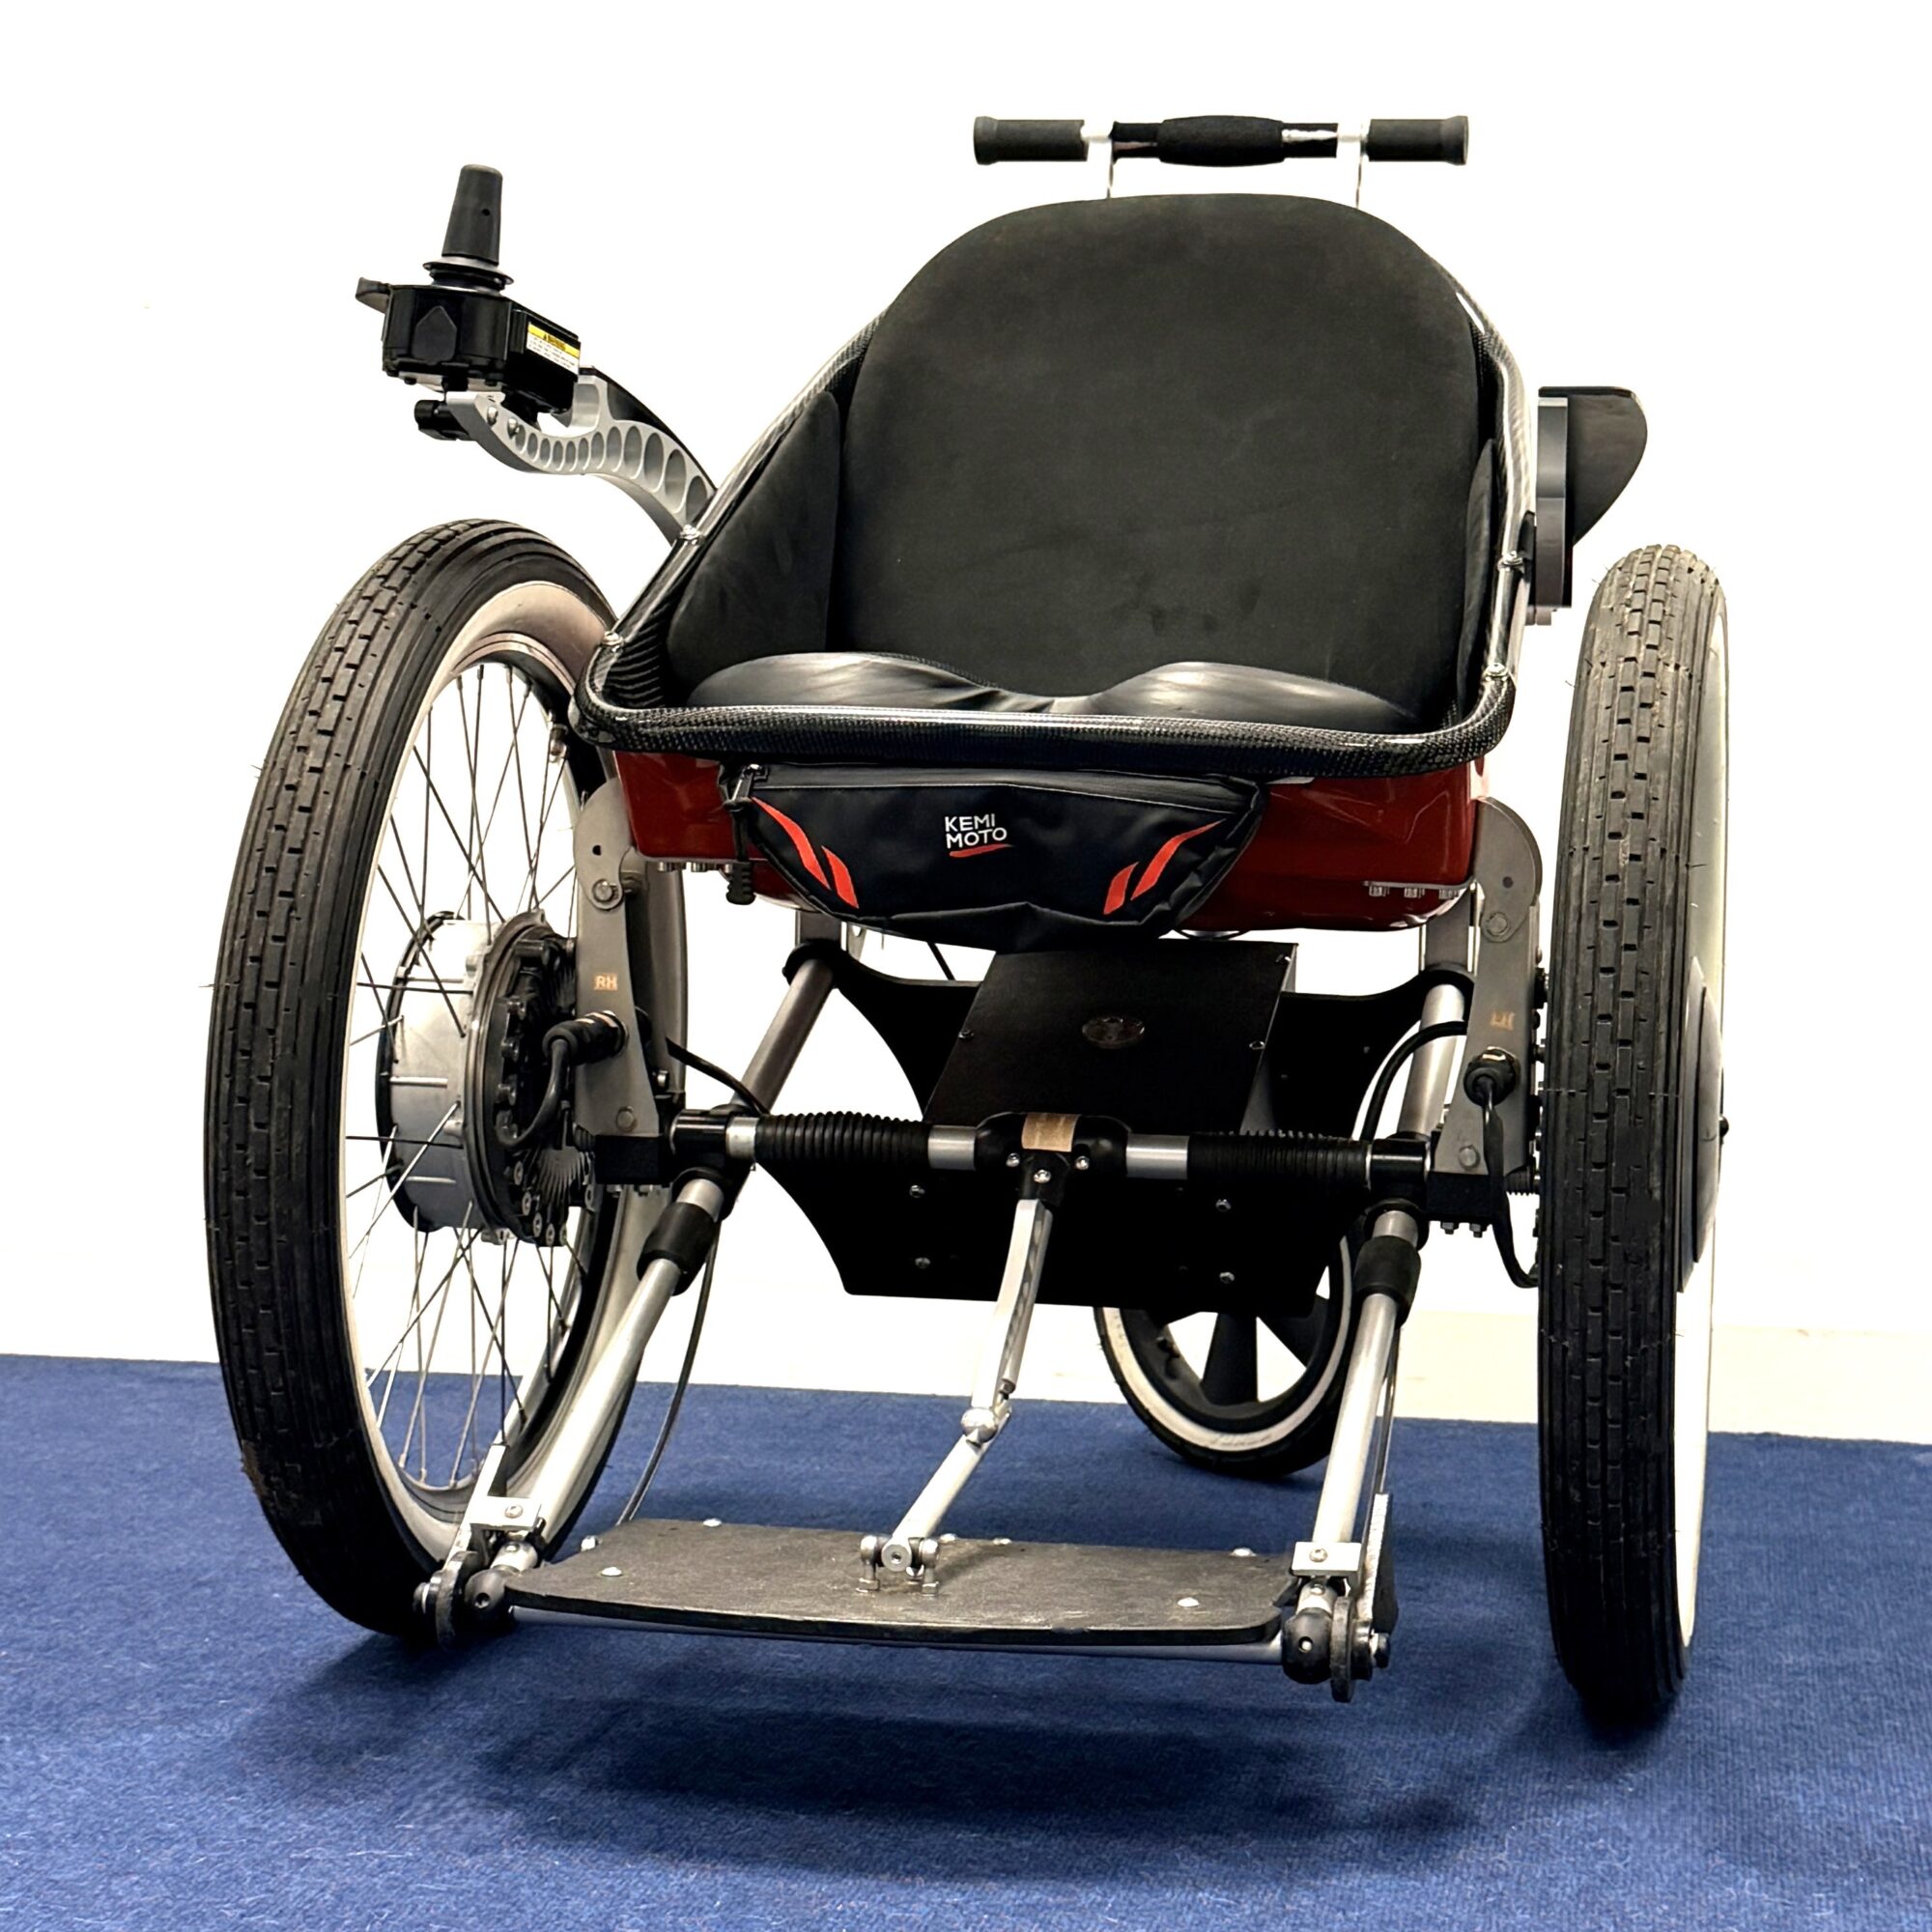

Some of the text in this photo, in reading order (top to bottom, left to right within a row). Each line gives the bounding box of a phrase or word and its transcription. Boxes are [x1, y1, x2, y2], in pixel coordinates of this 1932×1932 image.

[945, 813, 995, 832] KEMI
[946, 828, 1008, 848] MOTO
[593, 974, 618, 990] RH
